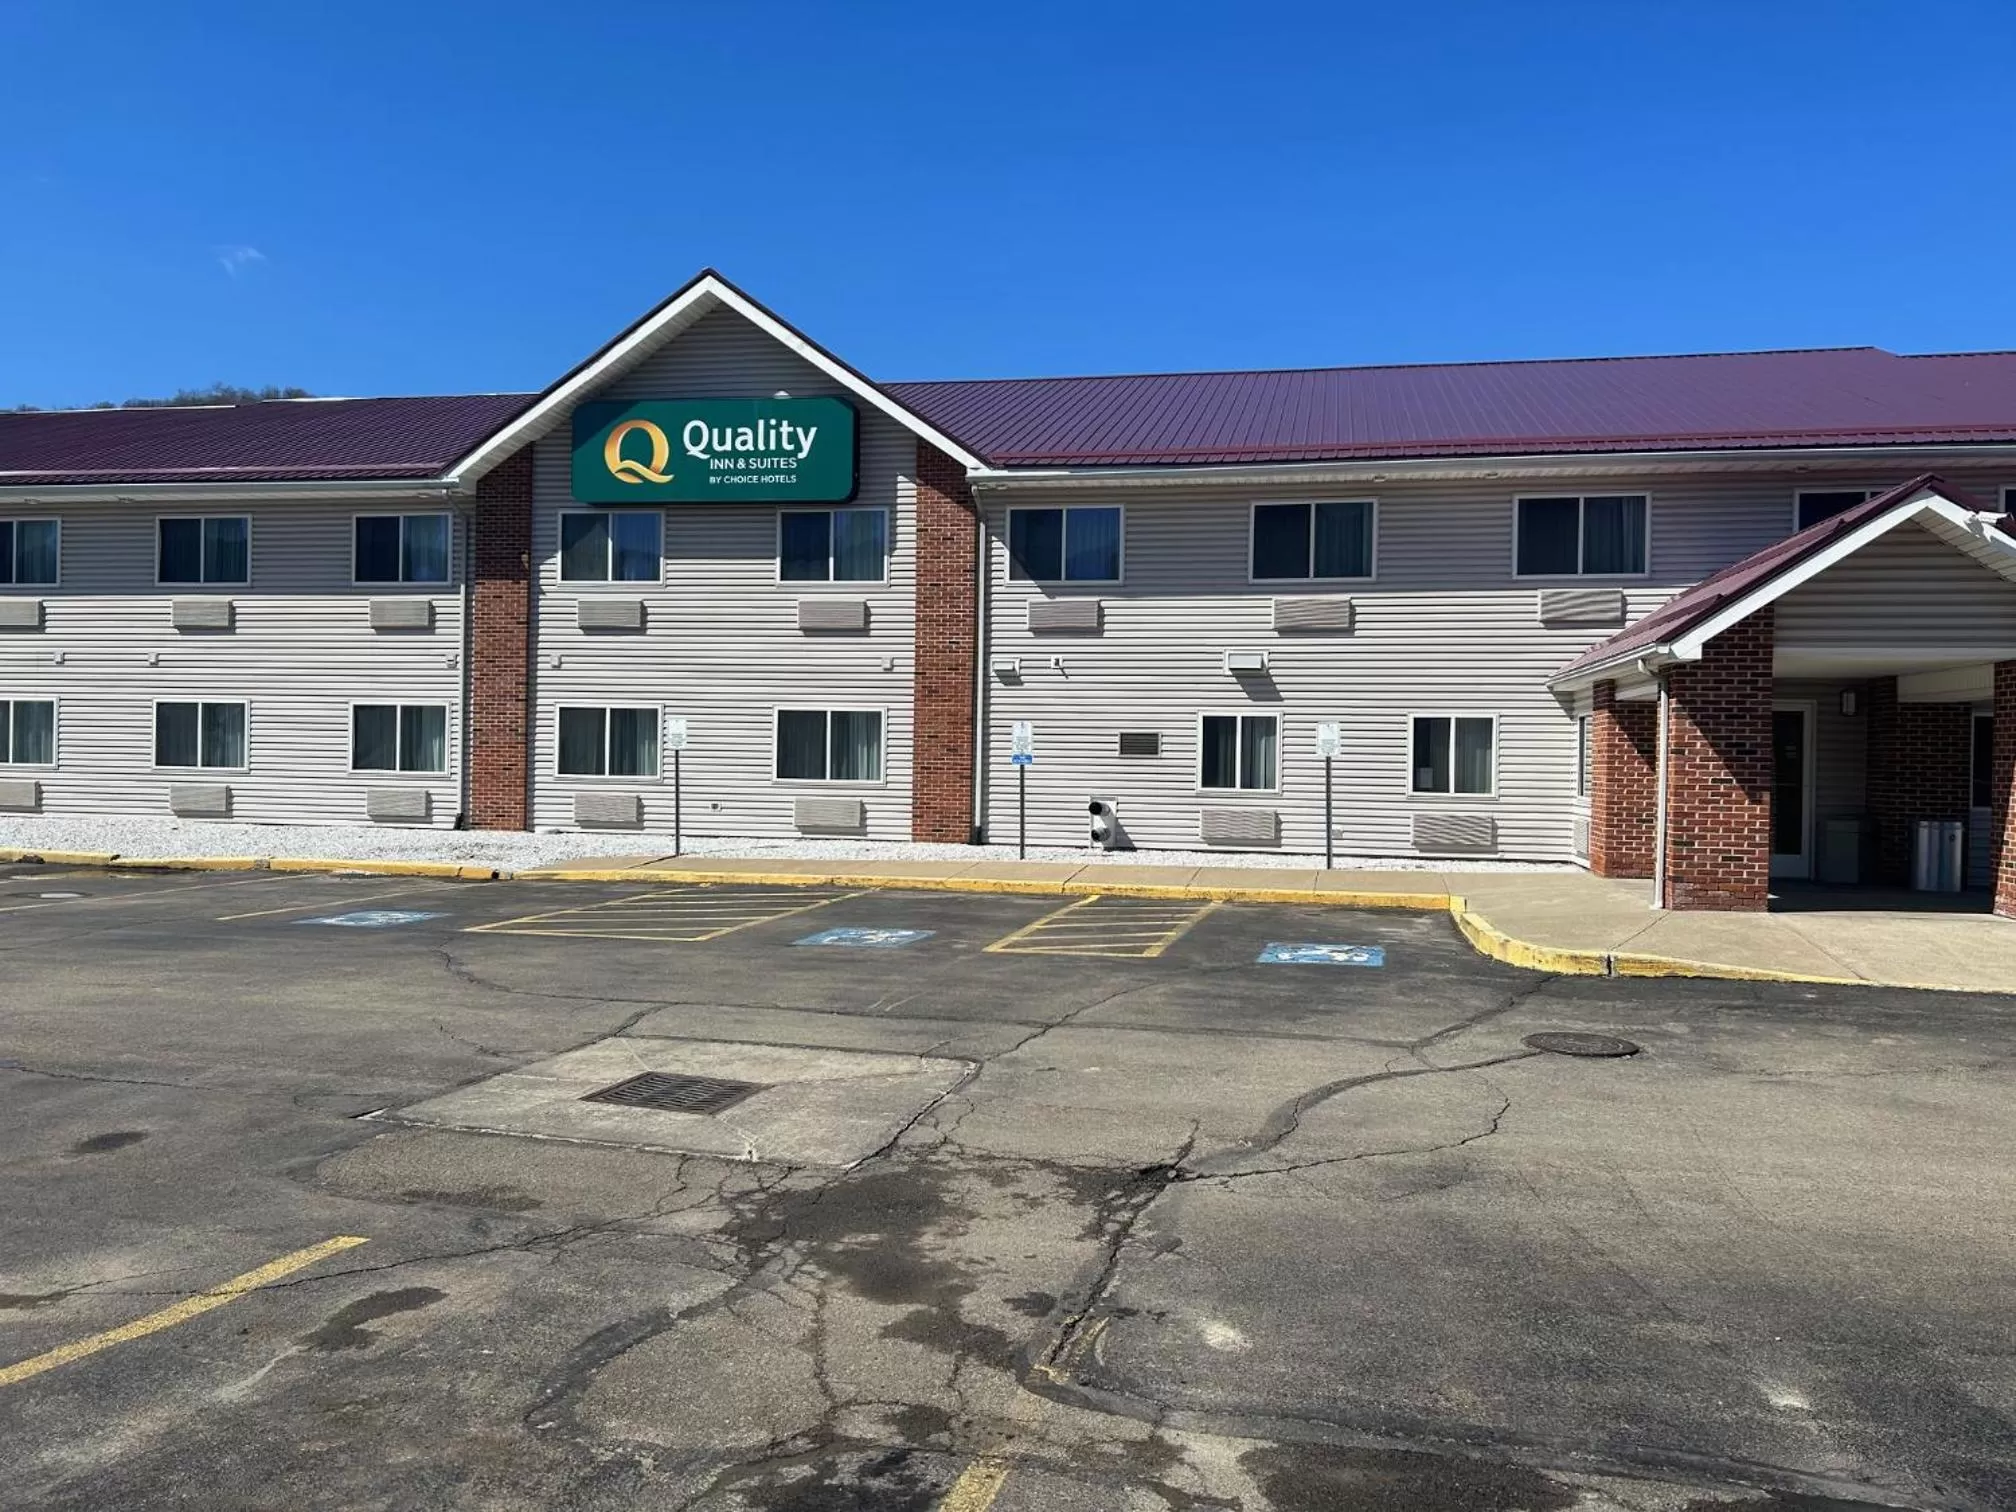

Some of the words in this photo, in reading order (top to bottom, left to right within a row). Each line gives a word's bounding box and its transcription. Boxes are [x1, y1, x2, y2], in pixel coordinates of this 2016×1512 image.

[604, 419, 675, 484] Q
[682, 418, 817, 460] Quality
[709, 458, 735, 470] INN
[737, 458, 747, 469] &
[748, 457, 798, 470] SUITES
[709, 475, 722, 484] BY
[723, 475, 759, 484] CHOICE
[761, 474, 797, 484] HOTELS
